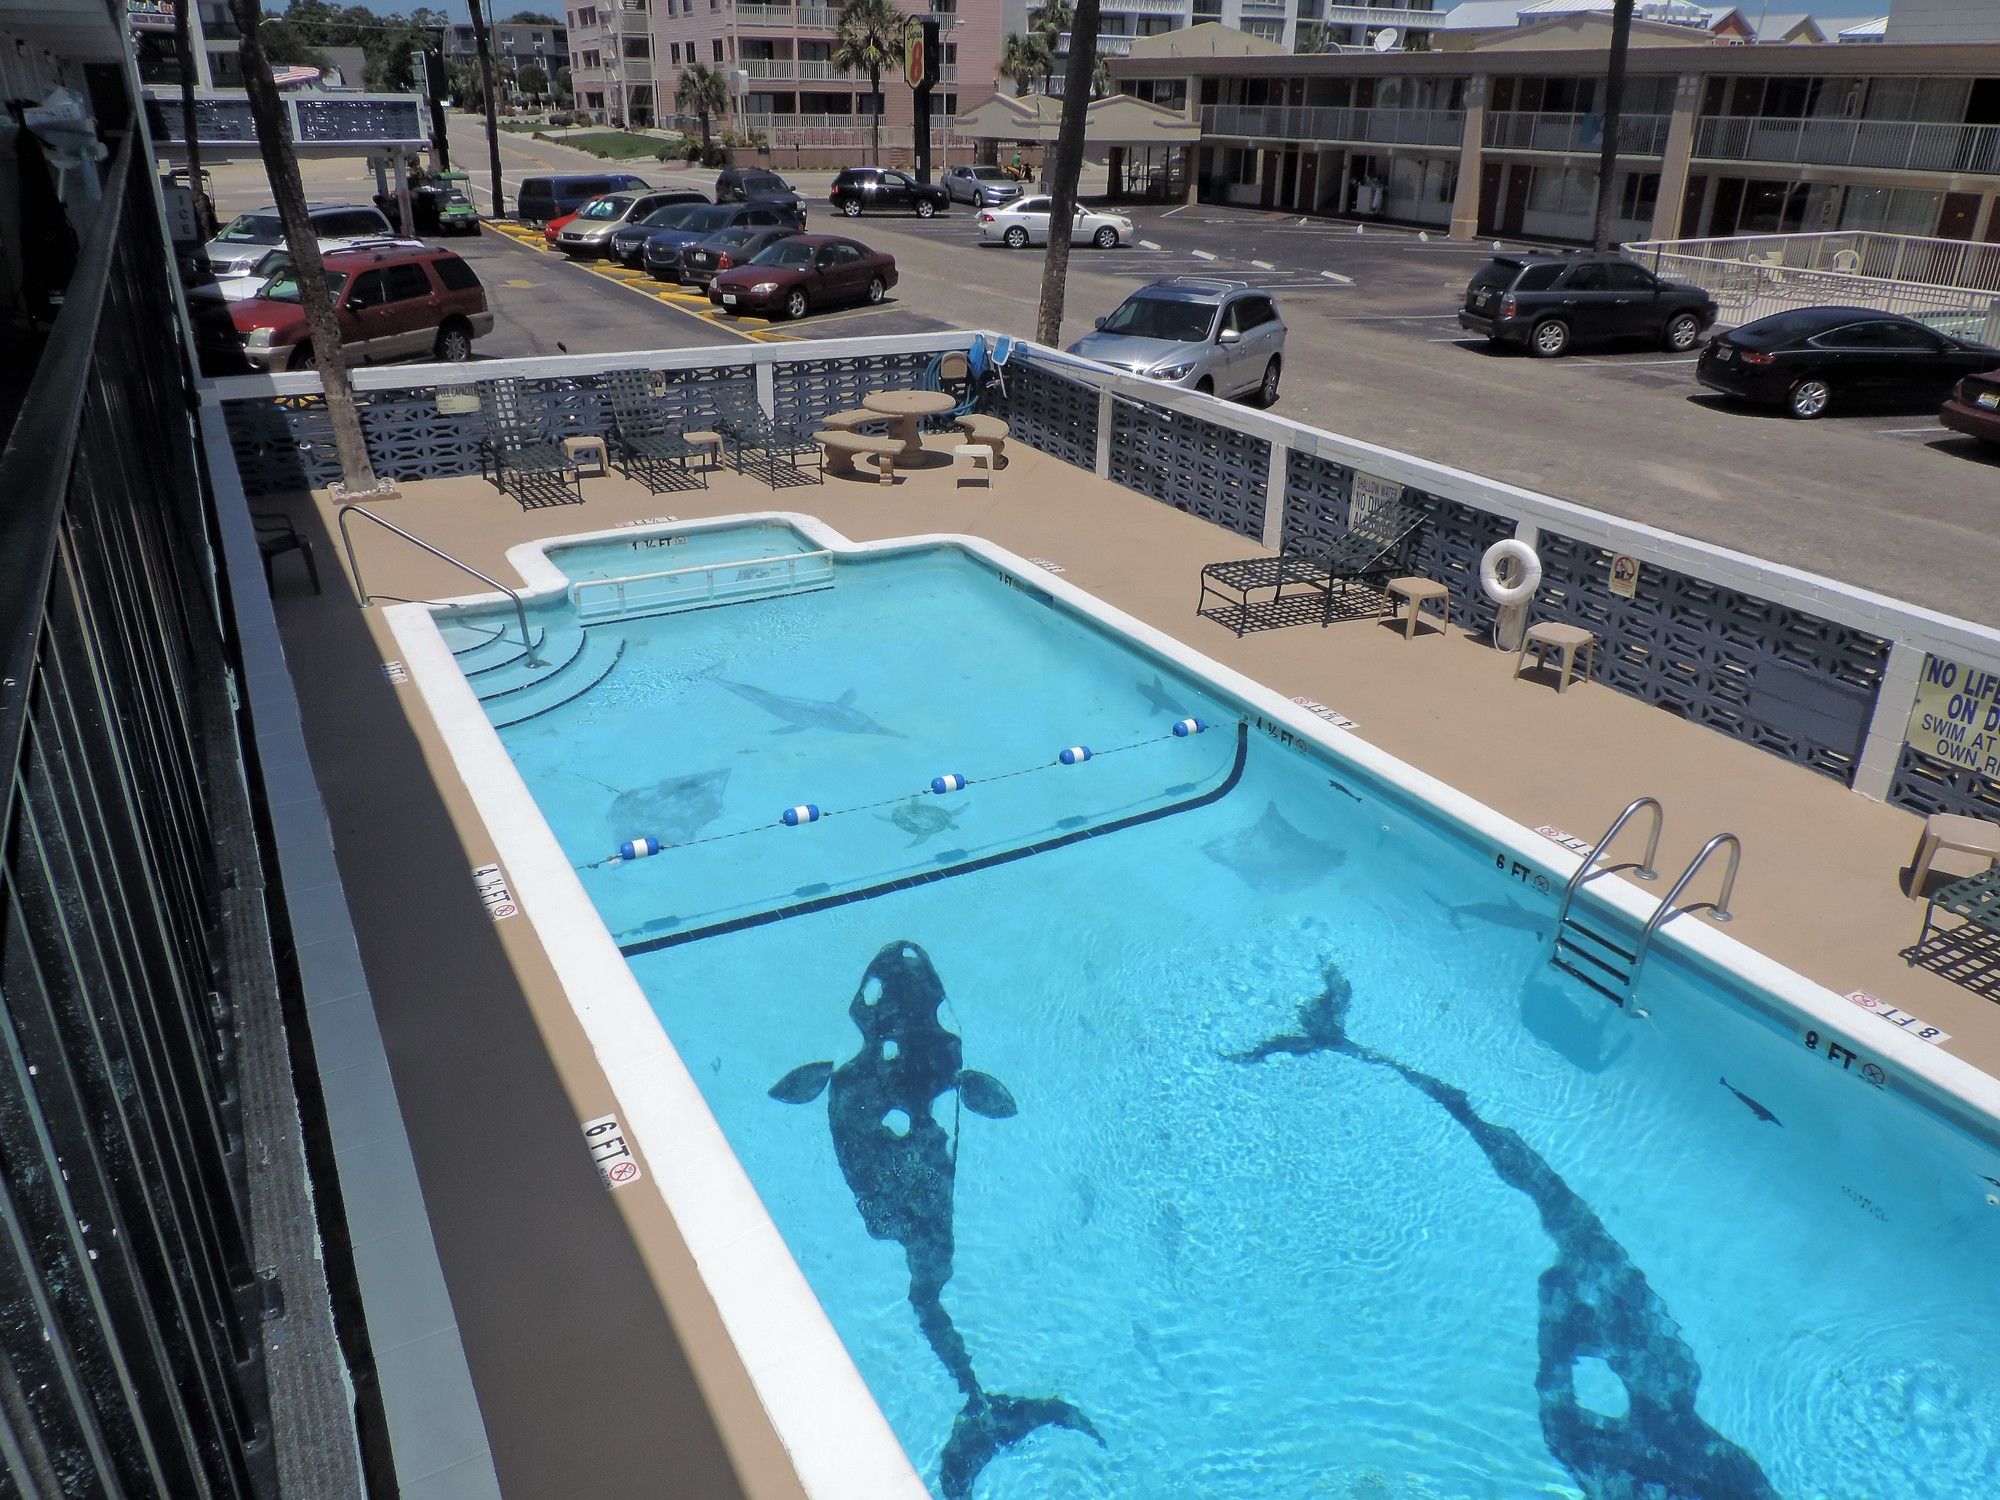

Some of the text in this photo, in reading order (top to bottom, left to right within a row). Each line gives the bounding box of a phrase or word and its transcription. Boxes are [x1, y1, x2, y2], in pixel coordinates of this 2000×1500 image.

[910, 41, 923, 81] 8
[178, 194, 191, 235] ICE
[1355, 491, 1366, 511] NO
[1357, 477, 1378, 495] SHALLOW
[1927, 657, 1957, 688] NO
[1948, 693, 1979, 725] ON
[1922, 713, 1997, 753] SWIM AT
[1936, 740, 1978, 766] OWN
[1496, 853, 1531, 883] 6 FT
[481, 890, 511, 906] FT
[1876, 1008, 1940, 1039] 8 FT
[1827, 1041, 1857, 1070] FT
[585, 1121, 630, 1163] 6 FT
